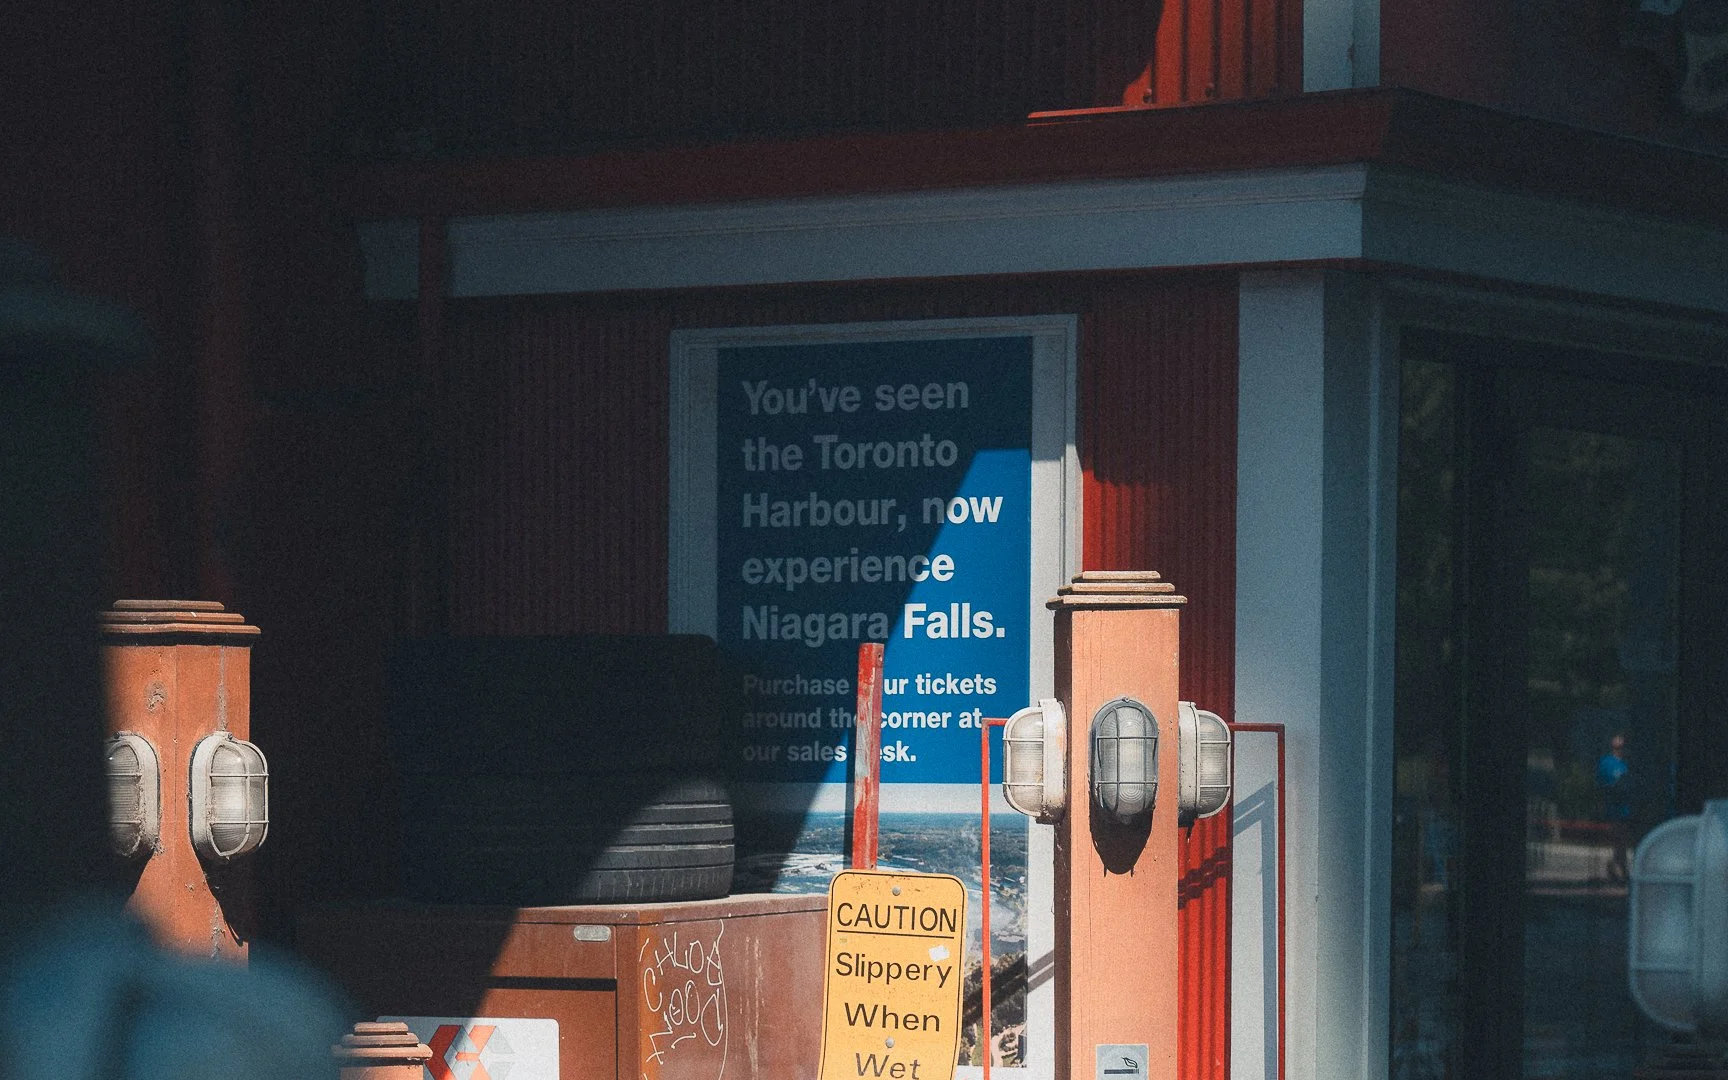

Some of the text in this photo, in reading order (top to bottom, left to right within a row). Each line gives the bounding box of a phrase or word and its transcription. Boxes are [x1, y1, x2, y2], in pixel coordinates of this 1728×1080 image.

[743, 380, 969, 415] You've seen
[742, 434, 958, 471] the Toronto
[743, 493, 1003, 531] Harbour, now
[742, 548, 955, 591] experience
[743, 603, 1005, 648] Niagara Falls.
[744, 673, 997, 696] Purchase ur tickets
[743, 708, 826, 729] around
[881, 711, 951, 729] corner
[958, 708, 982, 729] at
[743, 740, 916, 762] our sales sk.
[837, 902, 957, 932] CAUTION
[836, 952, 953, 988] Slippery
[844, 1002, 940, 1032] When
[855, 1052, 921, 1080] Wet
